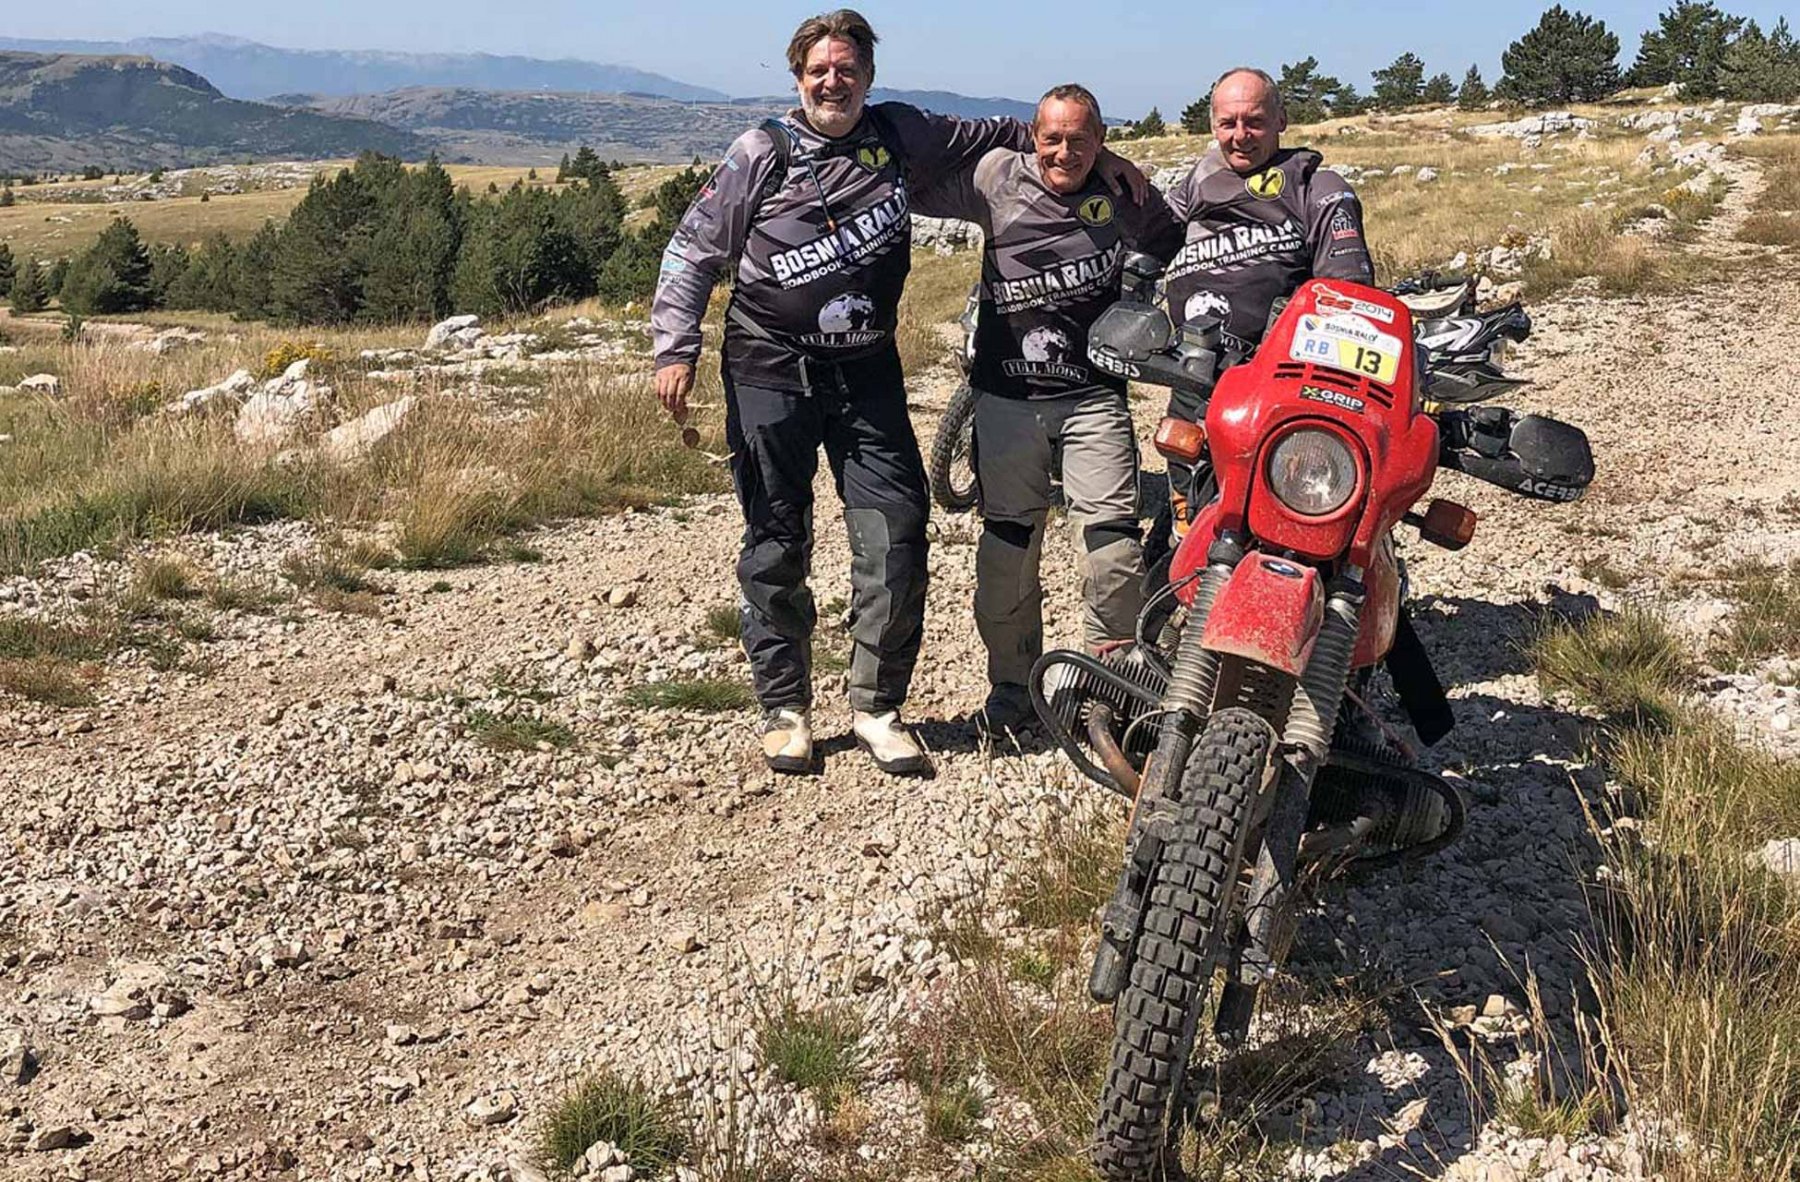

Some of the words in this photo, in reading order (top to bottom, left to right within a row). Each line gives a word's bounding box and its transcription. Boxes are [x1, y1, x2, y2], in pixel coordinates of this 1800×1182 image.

[770, 225, 861, 281] BOSNIA
[780, 260, 846, 291] ROADBOOK
[845, 228, 895, 262] TRAINING
[1217, 245, 1267, 266] TRAINING
[1269, 240, 1302, 253] CAMP
[1045, 284, 1095, 303] TRAINING
[1354, 301, 1392, 318] 2014
[1355, 346, 1382, 374] 13
